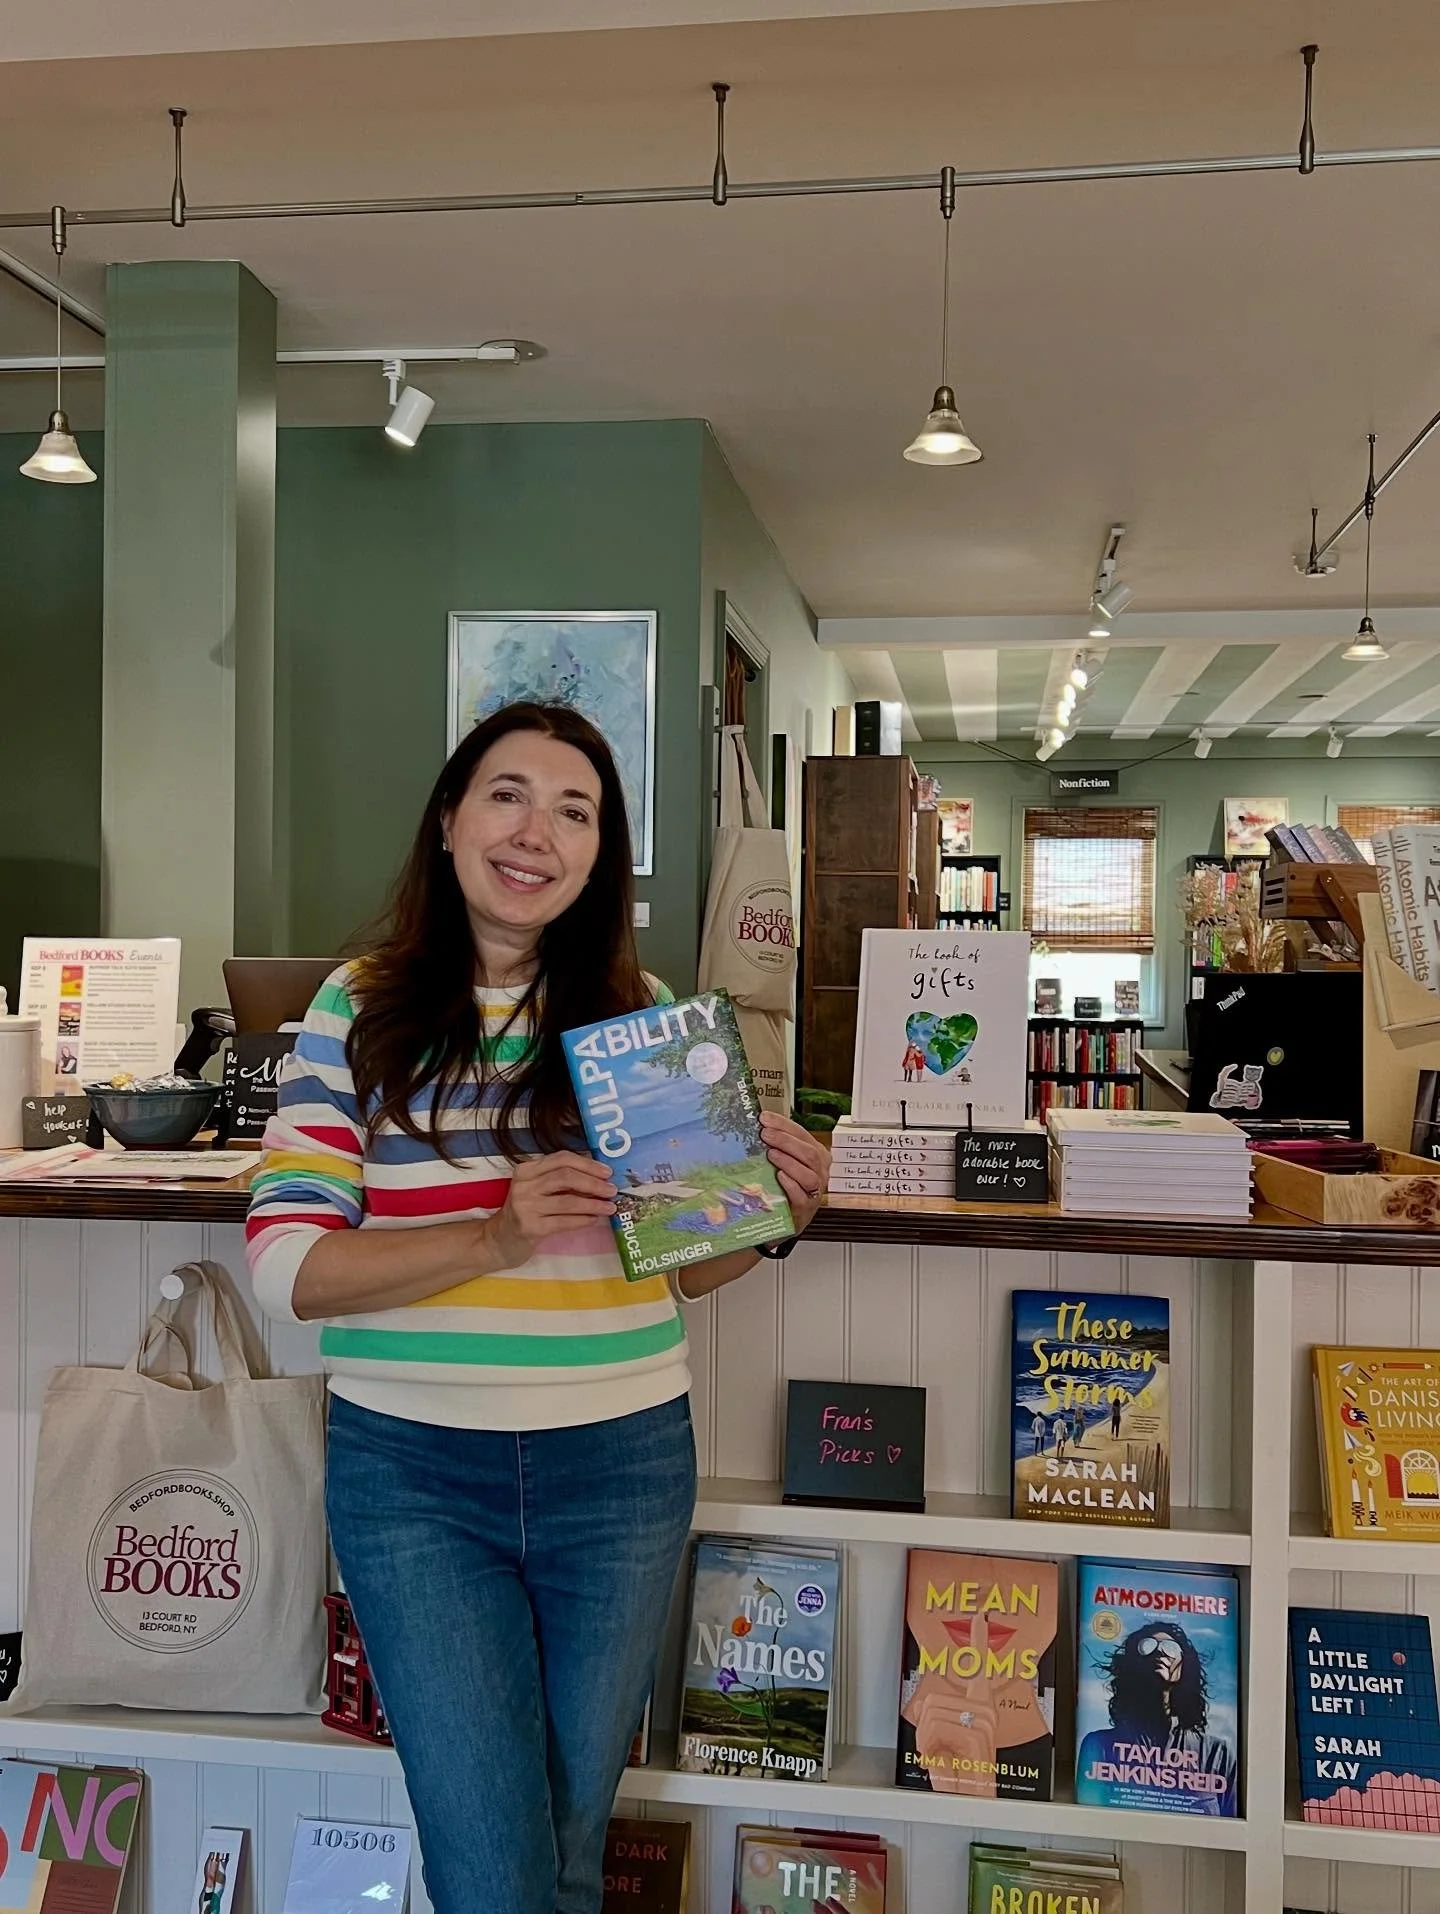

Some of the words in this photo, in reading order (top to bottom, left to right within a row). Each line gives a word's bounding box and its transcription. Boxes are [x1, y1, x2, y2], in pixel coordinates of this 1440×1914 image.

[1059, 778, 1110, 789] Nonfiction
[1376, 865, 1399, 926] Atomic
[1397, 858, 1420, 921] Atomic
[1409, 926, 1430, 982] Habits
[39, 950, 79, 961] Bedford
[80, 950, 124, 961] BOOKS
[909, 944, 929, 960] The
[934, 945, 965, 960] book
[968, 948, 980, 963] of
[911, 966, 976, 999] gifts
[736, 1077, 752, 1110] NOVEL
[44, 1102, 67, 1116] help
[746, 1111, 756, 1119] A
[957, 1102, 1005, 1113] DNBAR
[886, 1134, 914, 1147] gifts
[964, 1137, 981, 1152] The
[988, 1141, 1017, 1151] most
[886, 1150, 913, 1162] gifts
[962, 1156, 1010, 1169] adorable
[1015, 1156, 1044, 1170] book
[884, 1166, 911, 1178] gifts
[885, 1181, 912, 1193] gifts
[619, 1211, 642, 1260] BRUCE
[632, 1241, 713, 1275] HOLSINGER
[1044, 1301, 1132, 1343] These
[1029, 1338, 1159, 1375] Summer
[1044, 1374, 1153, 1413] Storms
[1381, 1377, 1398, 1386] THE
[1404, 1377, 1422, 1386] ART
[822, 1406, 873, 1431] Fran's
[820, 1439, 875, 1464] Picks
[1045, 1458, 1137, 1482] SARAH
[128, 1484, 235, 1517] BEDFORDBOOKS.SHOP
[1384, 1509, 1414, 1521] MEIK
[112, 1525, 239, 1562] Bedford
[100, 1557, 242, 1600] BOOKS
[798, 1597, 822, 1606] JENNA
[925, 1580, 1040, 1614] MEAN
[1094, 1585, 1229, 1616] ATMOSPHERE
[142, 1611, 150, 1620] 13
[152, 1611, 182, 1621] COURT
[184, 1613, 197, 1623] RD
[740, 1594, 788, 1628] The
[183, 1624, 197, 1634] NY
[1308, 1627, 1321, 1643] A
[693, 1621, 825, 1682] Names
[918, 1645, 1039, 1680] MOMS
[1308, 1649, 1368, 1669] LITTLE
[1310, 1672, 1404, 1695] DAYLIGHT
[999, 1699, 1007, 1708] A
[1311, 1695, 1353, 1715] LEFT
[685, 1736, 758, 1764] Florence
[761, 1746, 817, 1778] Knapp
[1113, 1742, 1199, 1769] TAYLOR
[1314, 1736, 1382, 1757] SARAH
[904, 1751, 945, 1769] EMMA
[952, 1758, 1039, 1779] ROSENBLUM
[1316, 1759, 1360, 1780] KAY
[1084, 1761, 1177, 1789] JENKINS
[1178, 1770, 1228, 1794] REID
[311, 1827, 396, 1853] 10506
[615, 1841, 668, 1860] DARK
[778, 1861, 841, 1901] THE
[848, 1879, 857, 1903] NOVEL
[991, 1884, 1100, 1914] BROKEN
